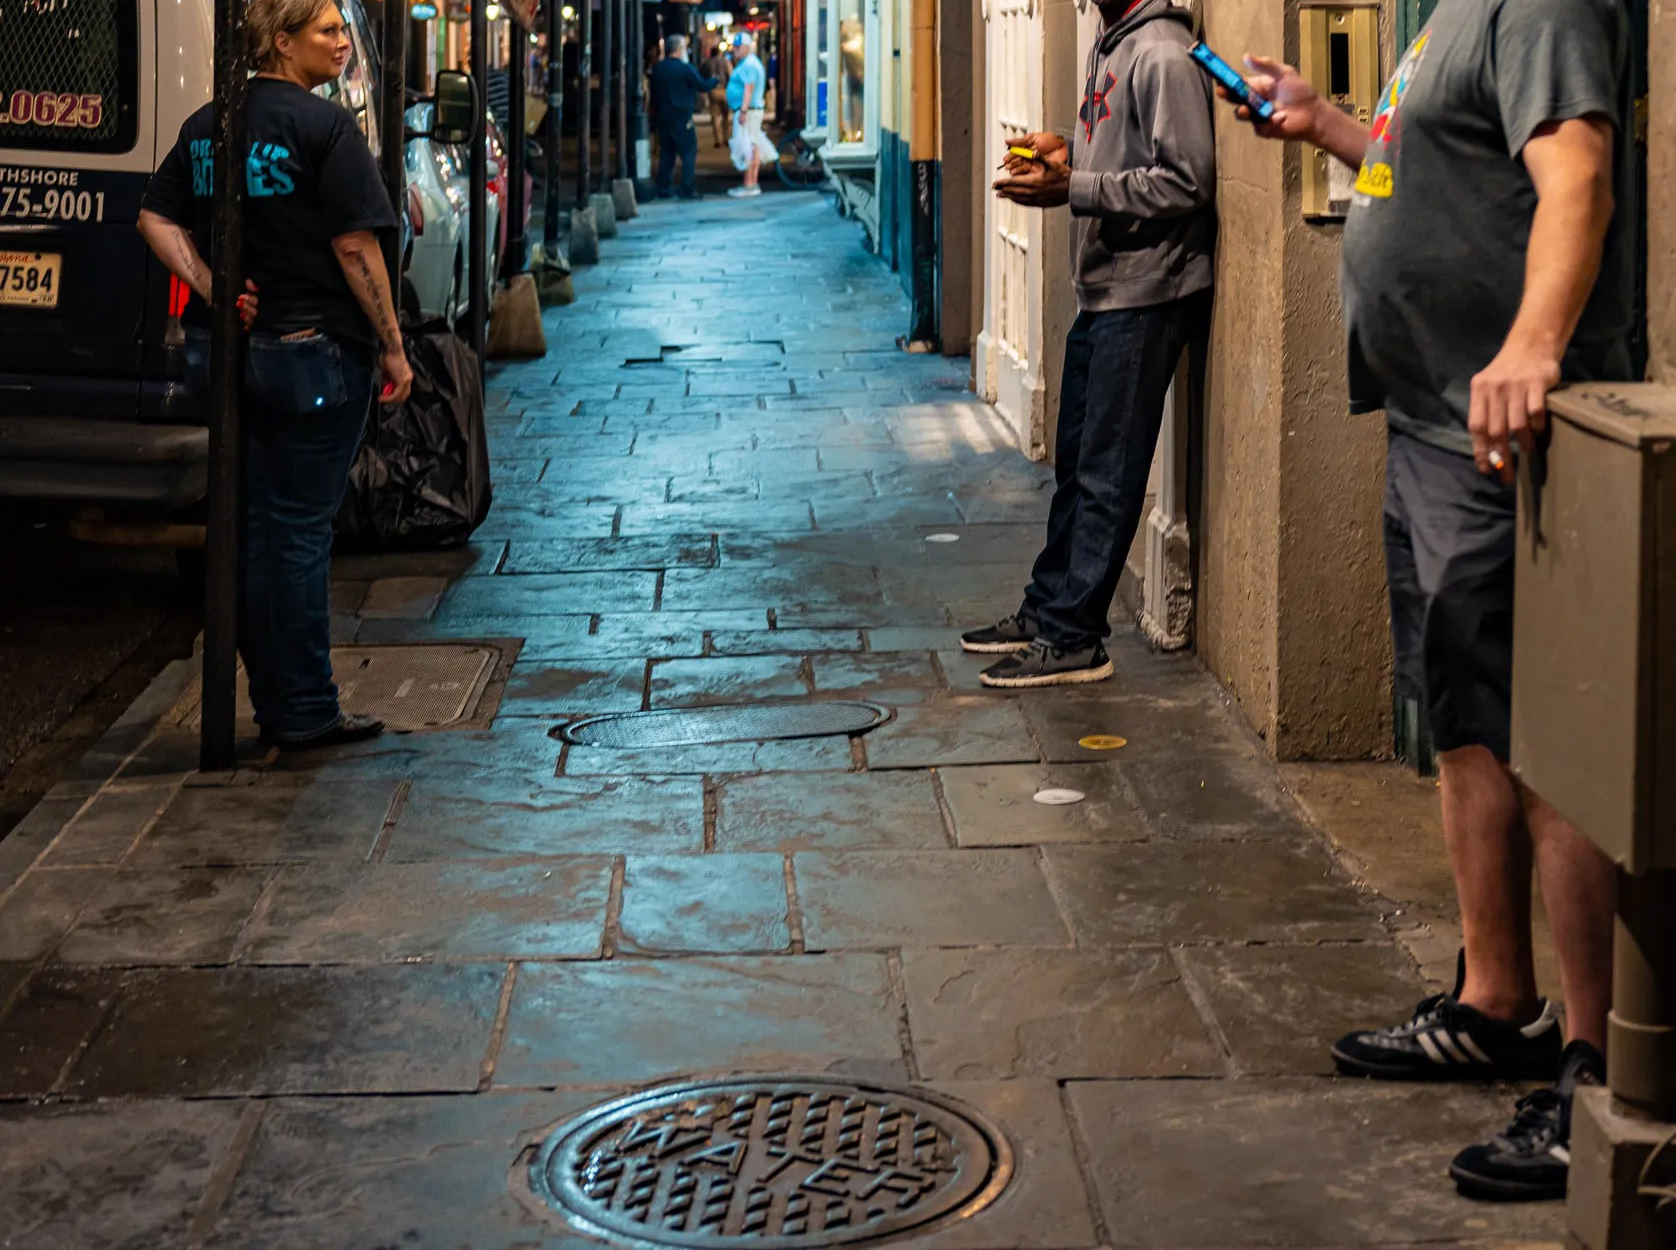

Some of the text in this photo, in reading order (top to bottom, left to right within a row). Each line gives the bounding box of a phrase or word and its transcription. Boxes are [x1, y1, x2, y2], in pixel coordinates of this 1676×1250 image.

[0, 89, 103, 129] .0625
[0, 265, 53, 293] 7584
[615, 1121, 936, 1208] WATER
